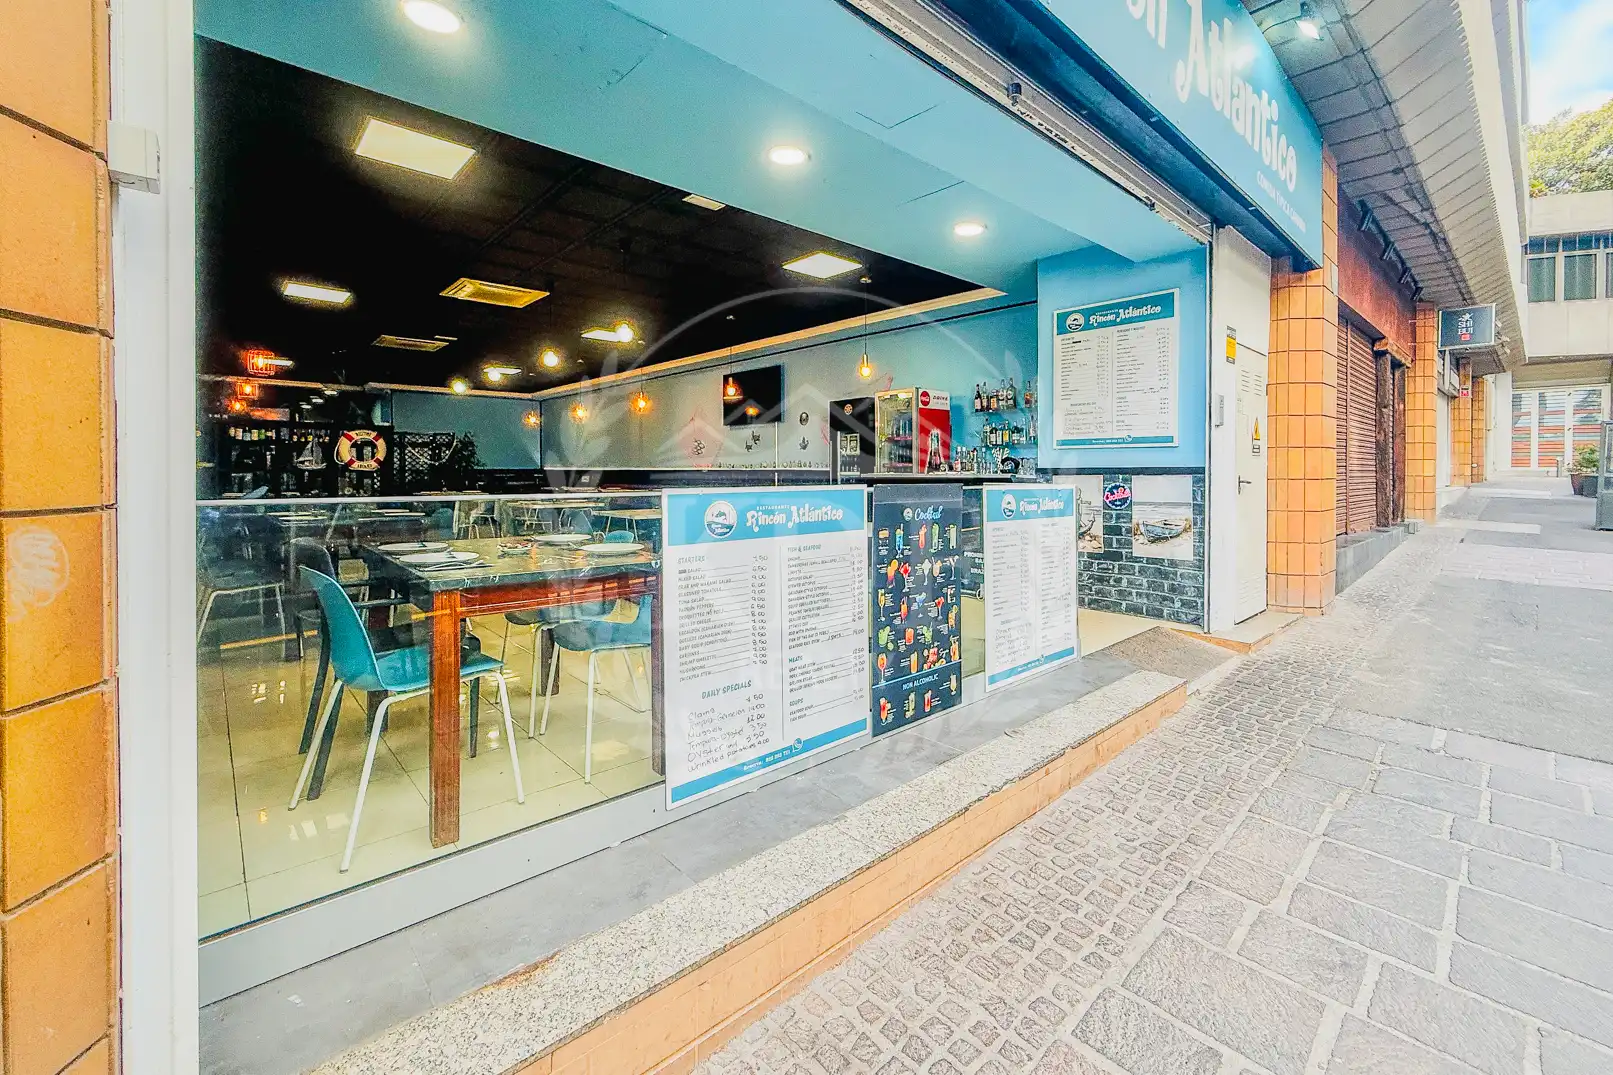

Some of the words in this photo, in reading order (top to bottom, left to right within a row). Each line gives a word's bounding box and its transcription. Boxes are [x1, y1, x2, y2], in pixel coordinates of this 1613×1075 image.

[1089, 314, 1116, 327] Rincón
[1116, 304, 1161, 323] Atlántico
[746, 510, 787, 532] Rincón
[788, 503, 844, 529] Atlántico
[678, 556, 706, 565] STARTERS
[701, 688, 721, 700] DAILY
[722, 680, 752, 694] SPECIALS
[914, 673, 938, 688] ALCOHOLIC
